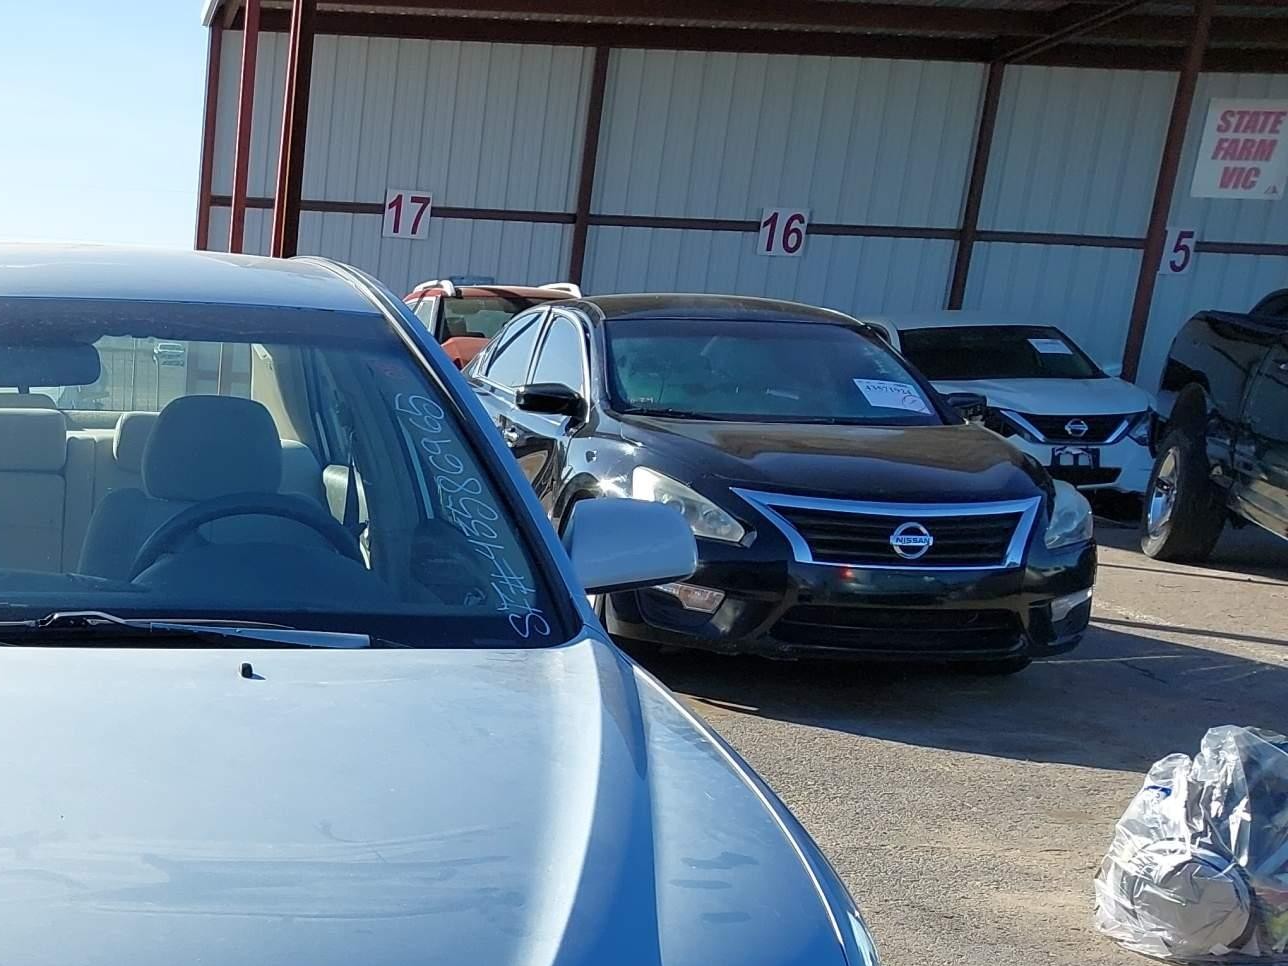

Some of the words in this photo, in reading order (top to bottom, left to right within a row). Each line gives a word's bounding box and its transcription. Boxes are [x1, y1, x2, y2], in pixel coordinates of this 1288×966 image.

[1216, 109, 1288, 134] STATE
[1211, 137, 1278, 162] FARM
[1219, 166, 1261, 190] VIC
[388, 194, 431, 235] 17
[762, 212, 805, 254] 16
[1167, 230, 1195, 272] 5
